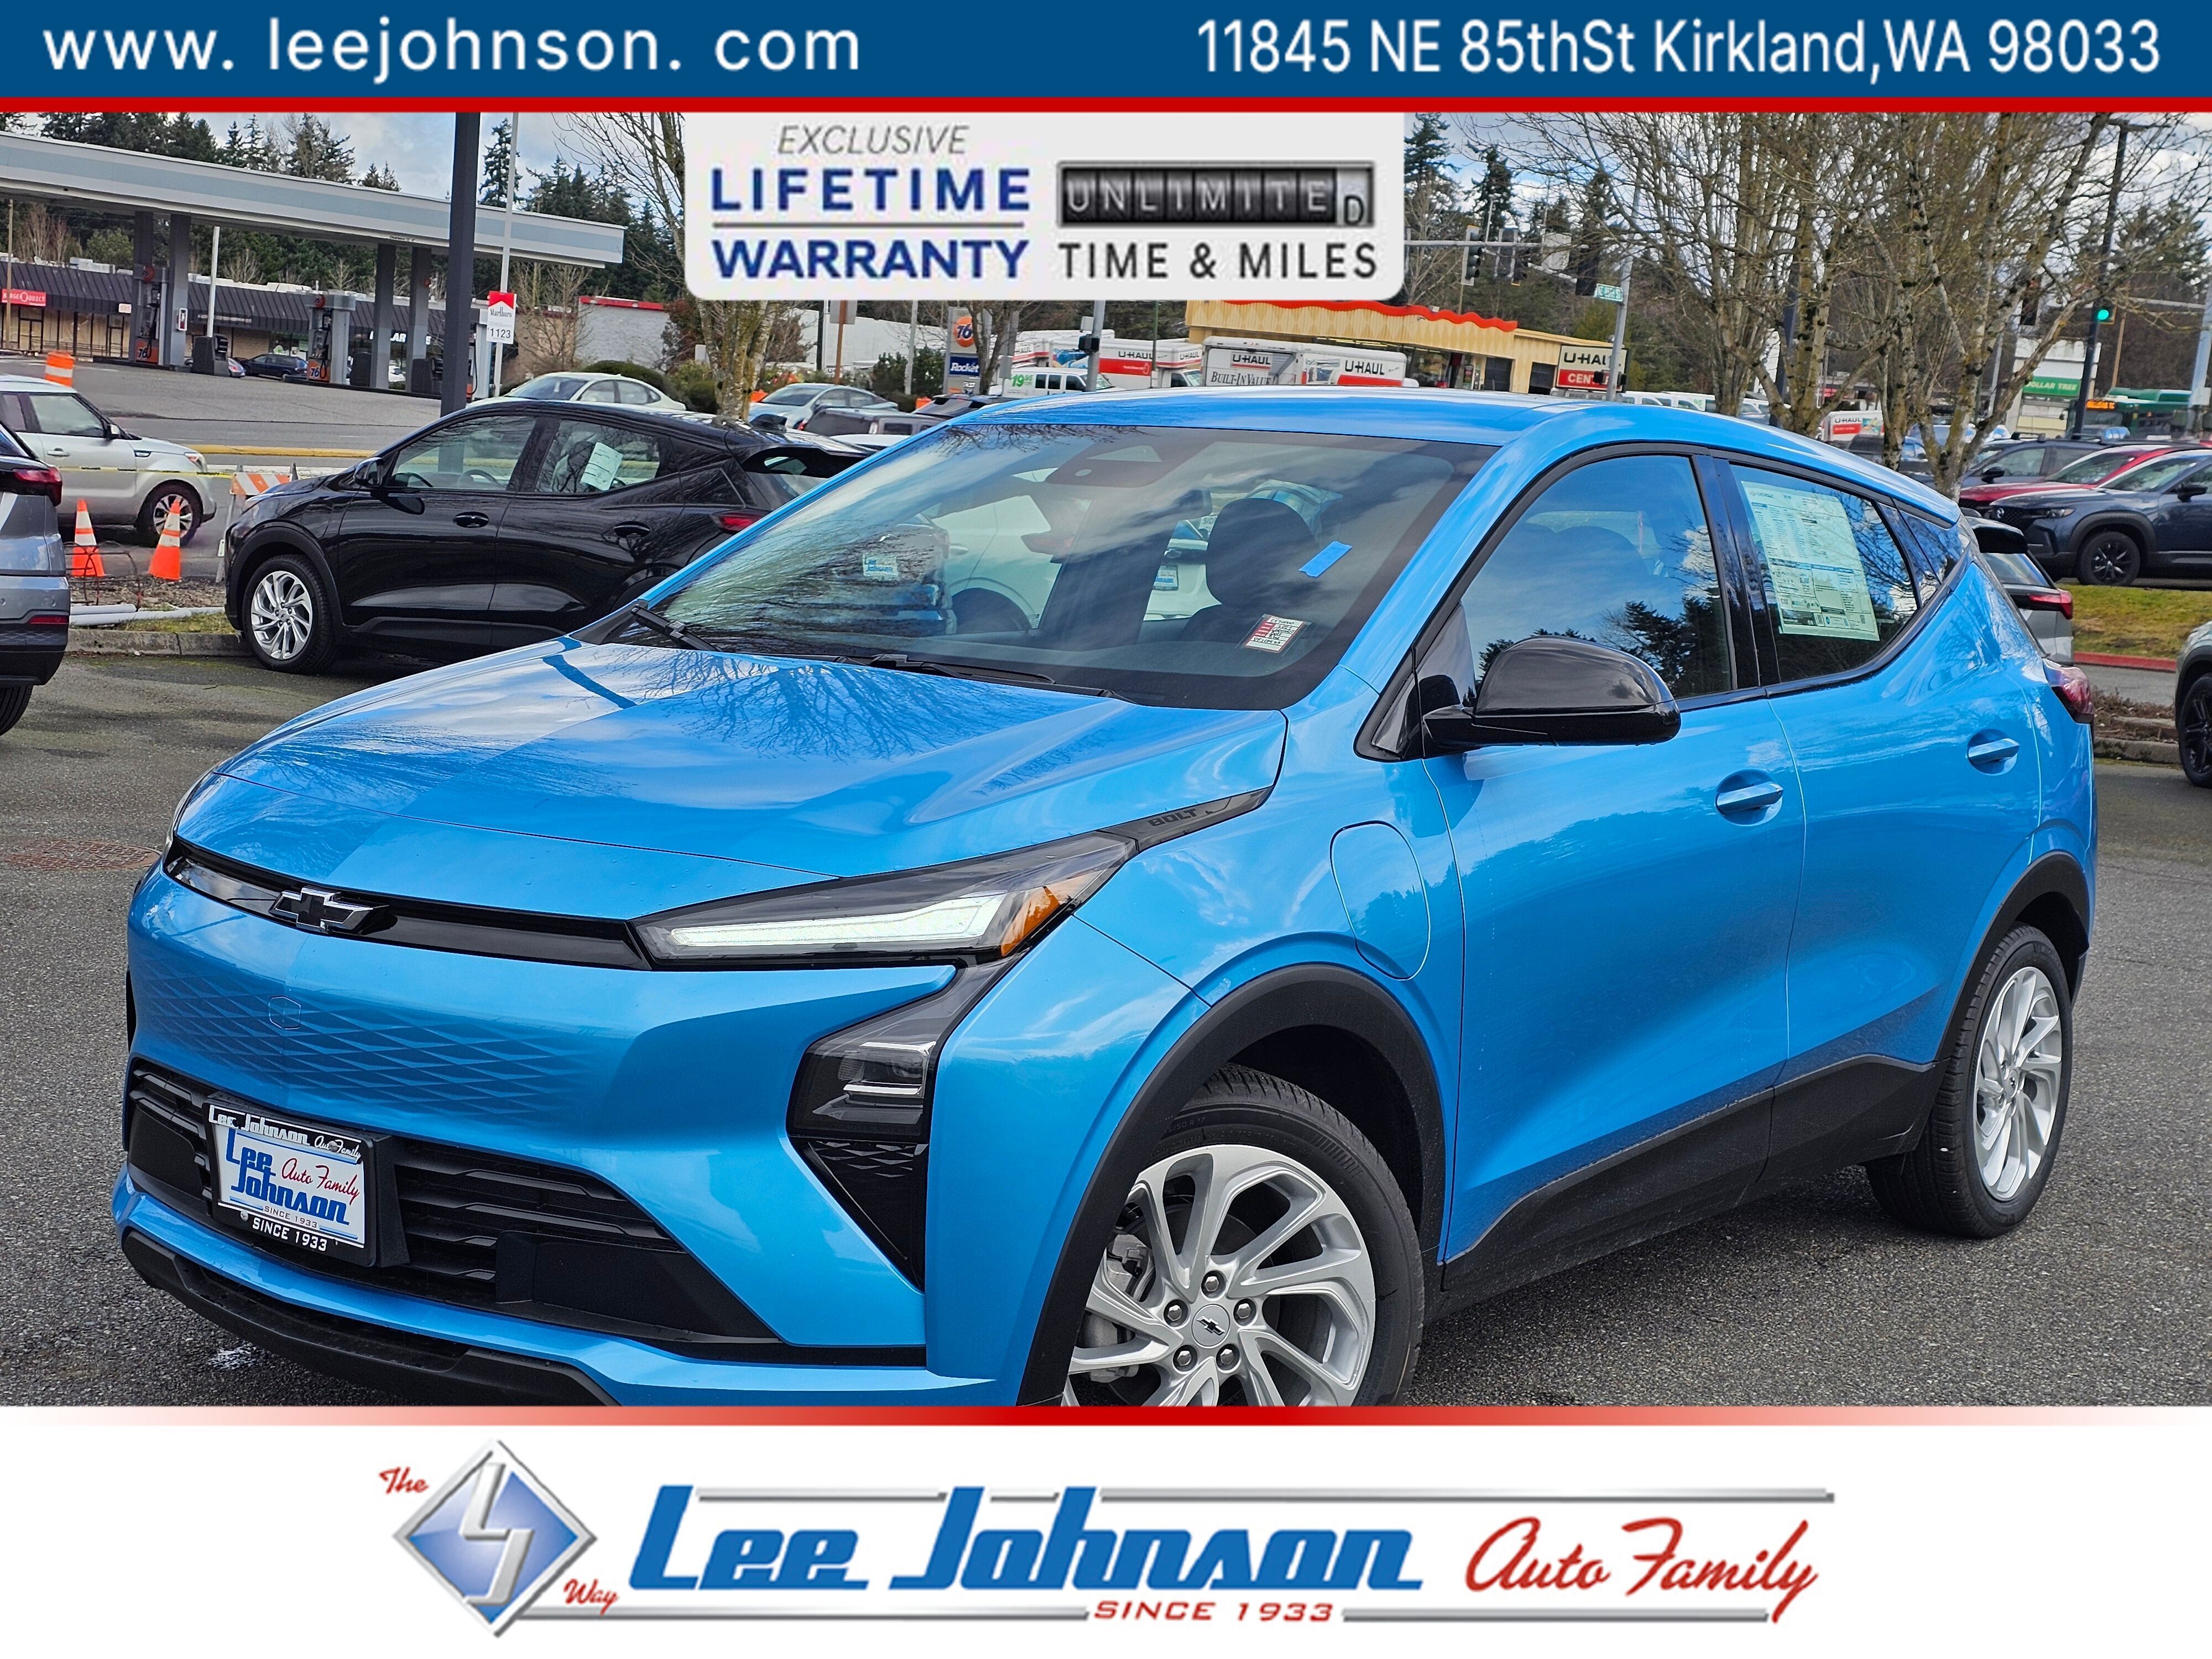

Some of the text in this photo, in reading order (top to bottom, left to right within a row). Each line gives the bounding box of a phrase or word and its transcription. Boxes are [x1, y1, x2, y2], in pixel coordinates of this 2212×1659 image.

[490, 306, 512, 318] Marlboro
[956, 324, 973, 339] 76
[1118, 351, 1153, 360] U-HAUL
[1232, 353, 1271, 366] U-HAUL
[309, 367, 320, 378] 76
[950, 361, 979, 373] Rocket
[1344, 359, 1385, 376] U-HAUL
[1147, 808, 1197, 827] BOLT
[241, 1113, 310, 1146] Johnson
[226, 1126, 276, 1176] Lee
[281, 1157, 361, 1206] Auto Family
[230, 1159, 350, 1226] Johnson
[264, 1205, 319, 1229] SINCE 1933
[252, 1217, 328, 1252] SINCE 1933
